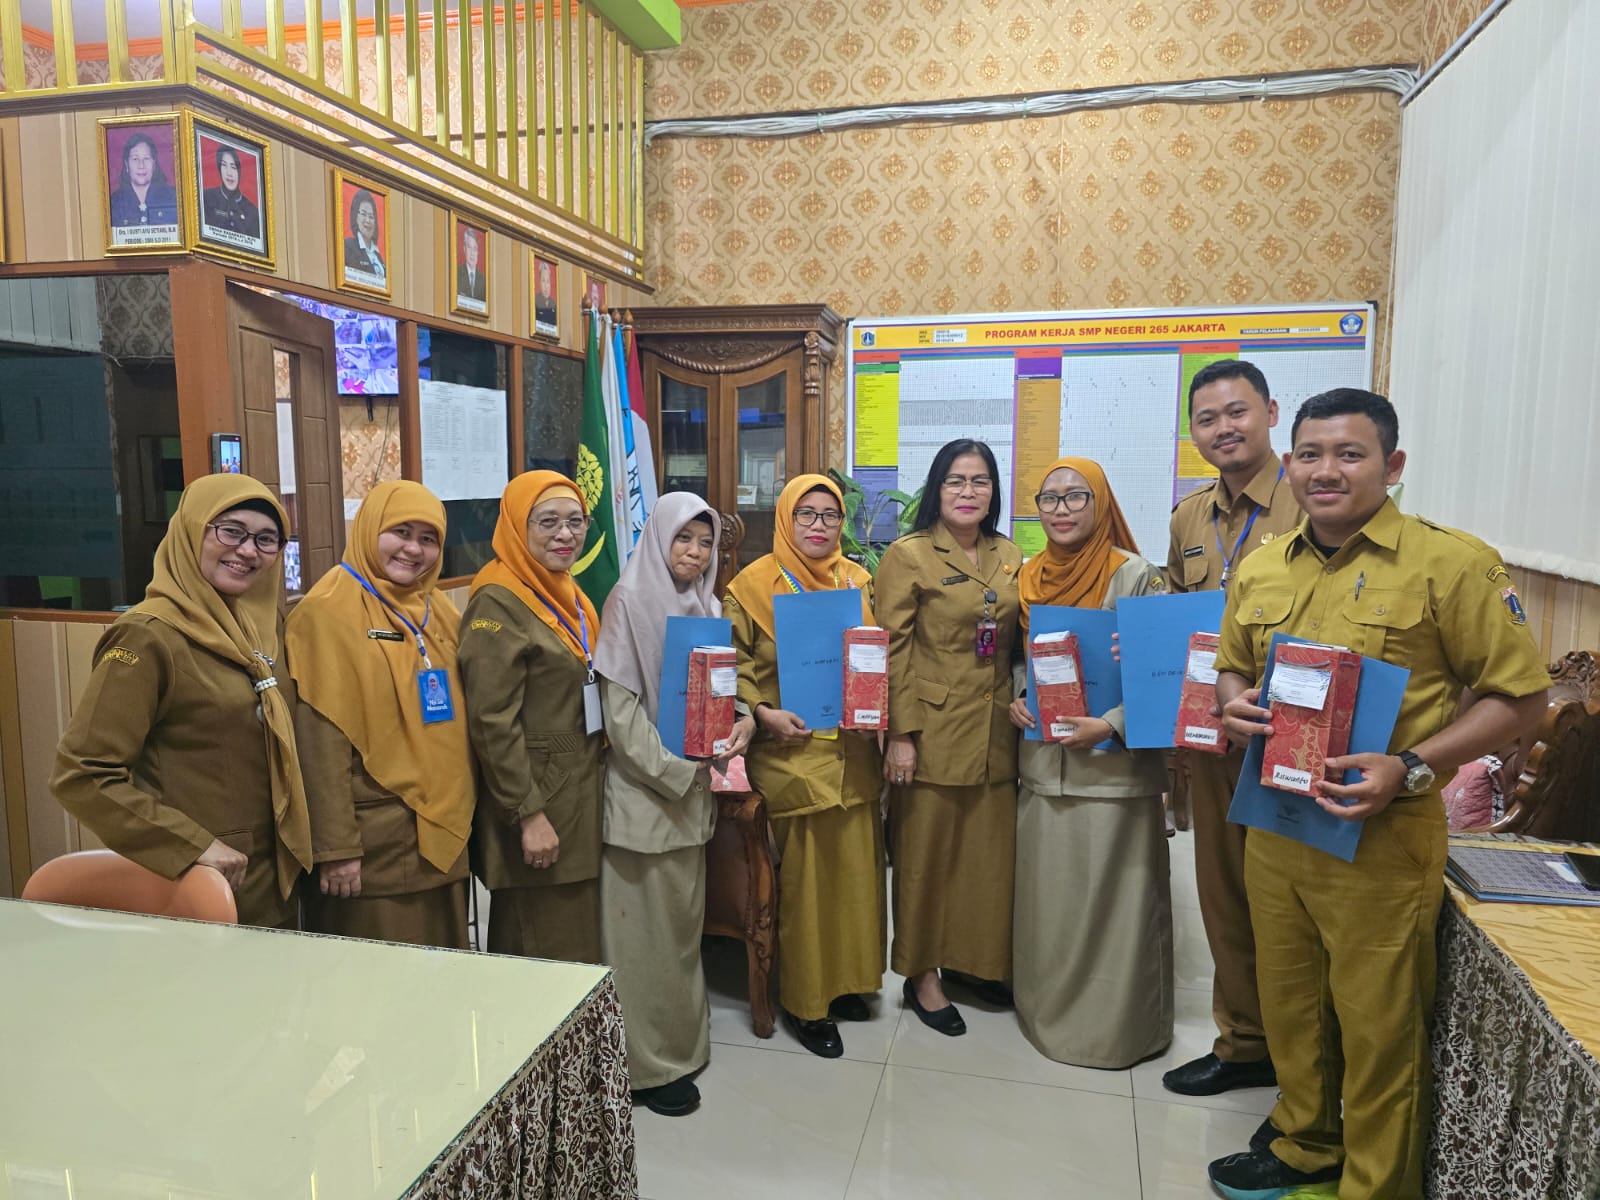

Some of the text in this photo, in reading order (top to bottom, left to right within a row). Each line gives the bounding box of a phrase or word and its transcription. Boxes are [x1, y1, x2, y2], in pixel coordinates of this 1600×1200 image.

[985, 322, 1226, 339] PROGRAM KERJA SMP NEGERI 265 JAKARTA
